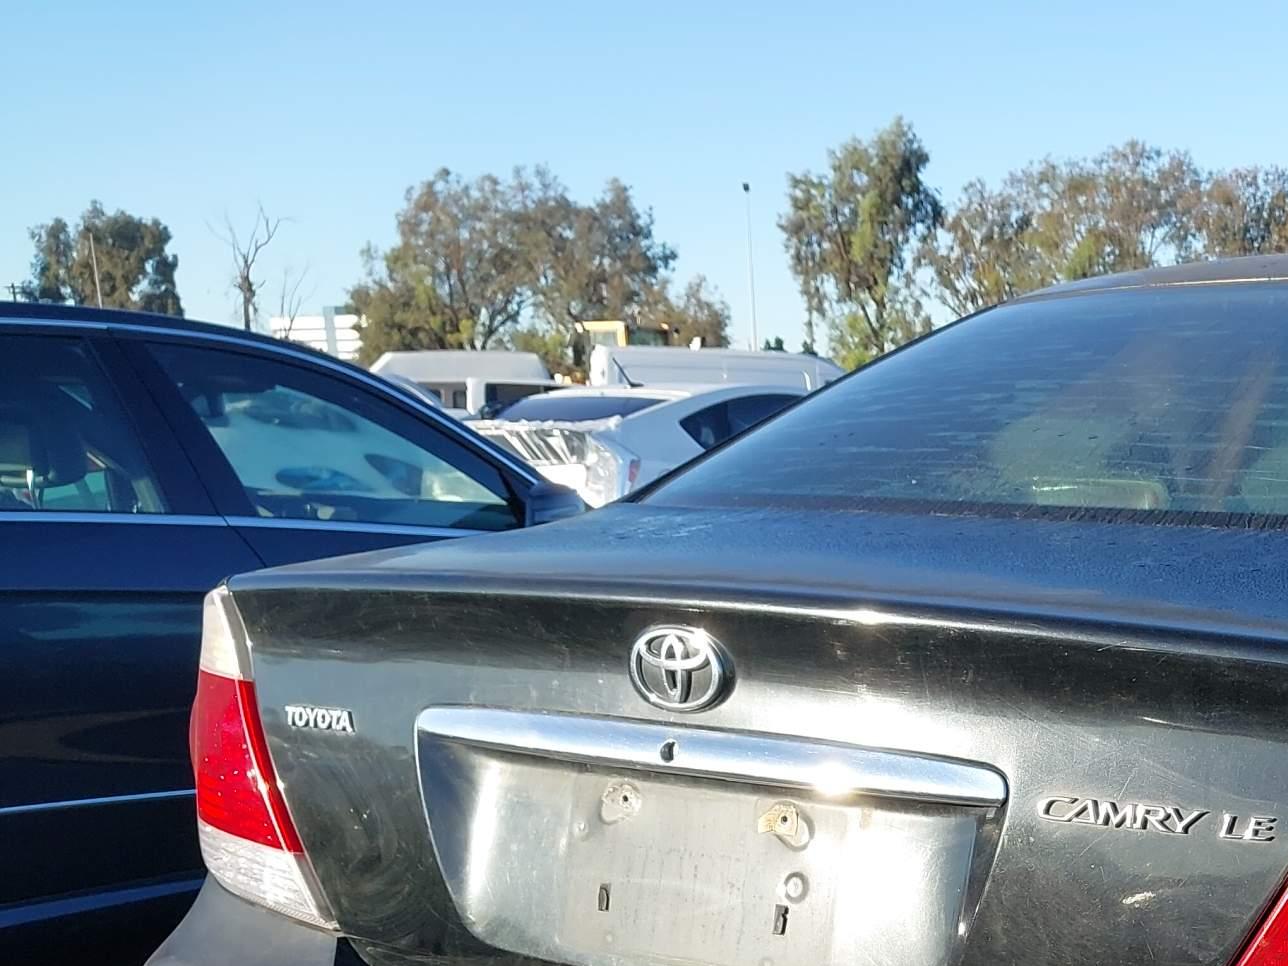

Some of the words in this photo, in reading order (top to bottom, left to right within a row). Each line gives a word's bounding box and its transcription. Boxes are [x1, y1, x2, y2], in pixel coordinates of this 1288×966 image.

[284, 705, 355, 733] TOYOTA
[1037, 796, 1210, 835] CAMRY
[1219, 813, 1278, 842] LE
